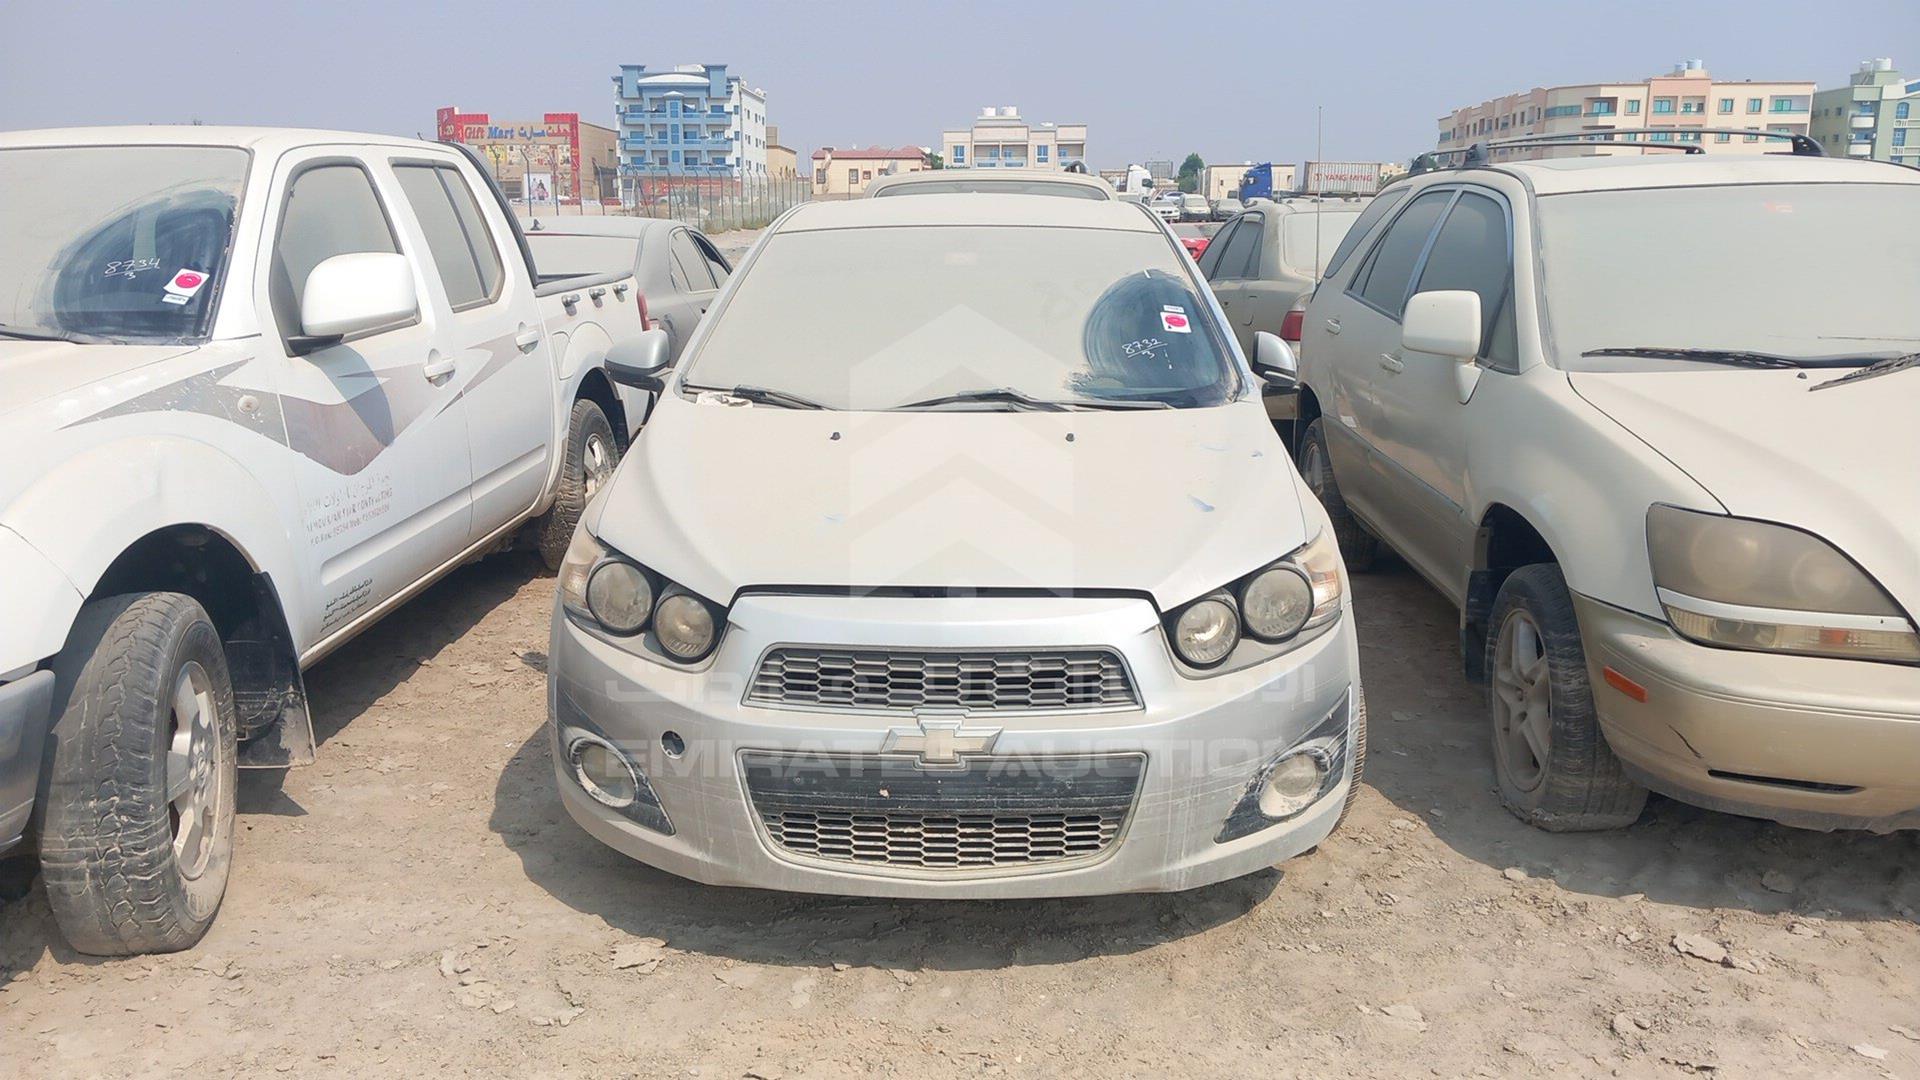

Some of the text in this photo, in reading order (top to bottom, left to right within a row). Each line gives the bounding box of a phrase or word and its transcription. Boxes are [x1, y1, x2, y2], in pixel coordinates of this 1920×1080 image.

[464, 126, 485, 139] Gift
[487, 126, 515, 139] Mart
[1324, 173, 1373, 182] YANG MING
[104, 258, 161, 275] 8734
[1122, 338, 1163, 355] 8732
